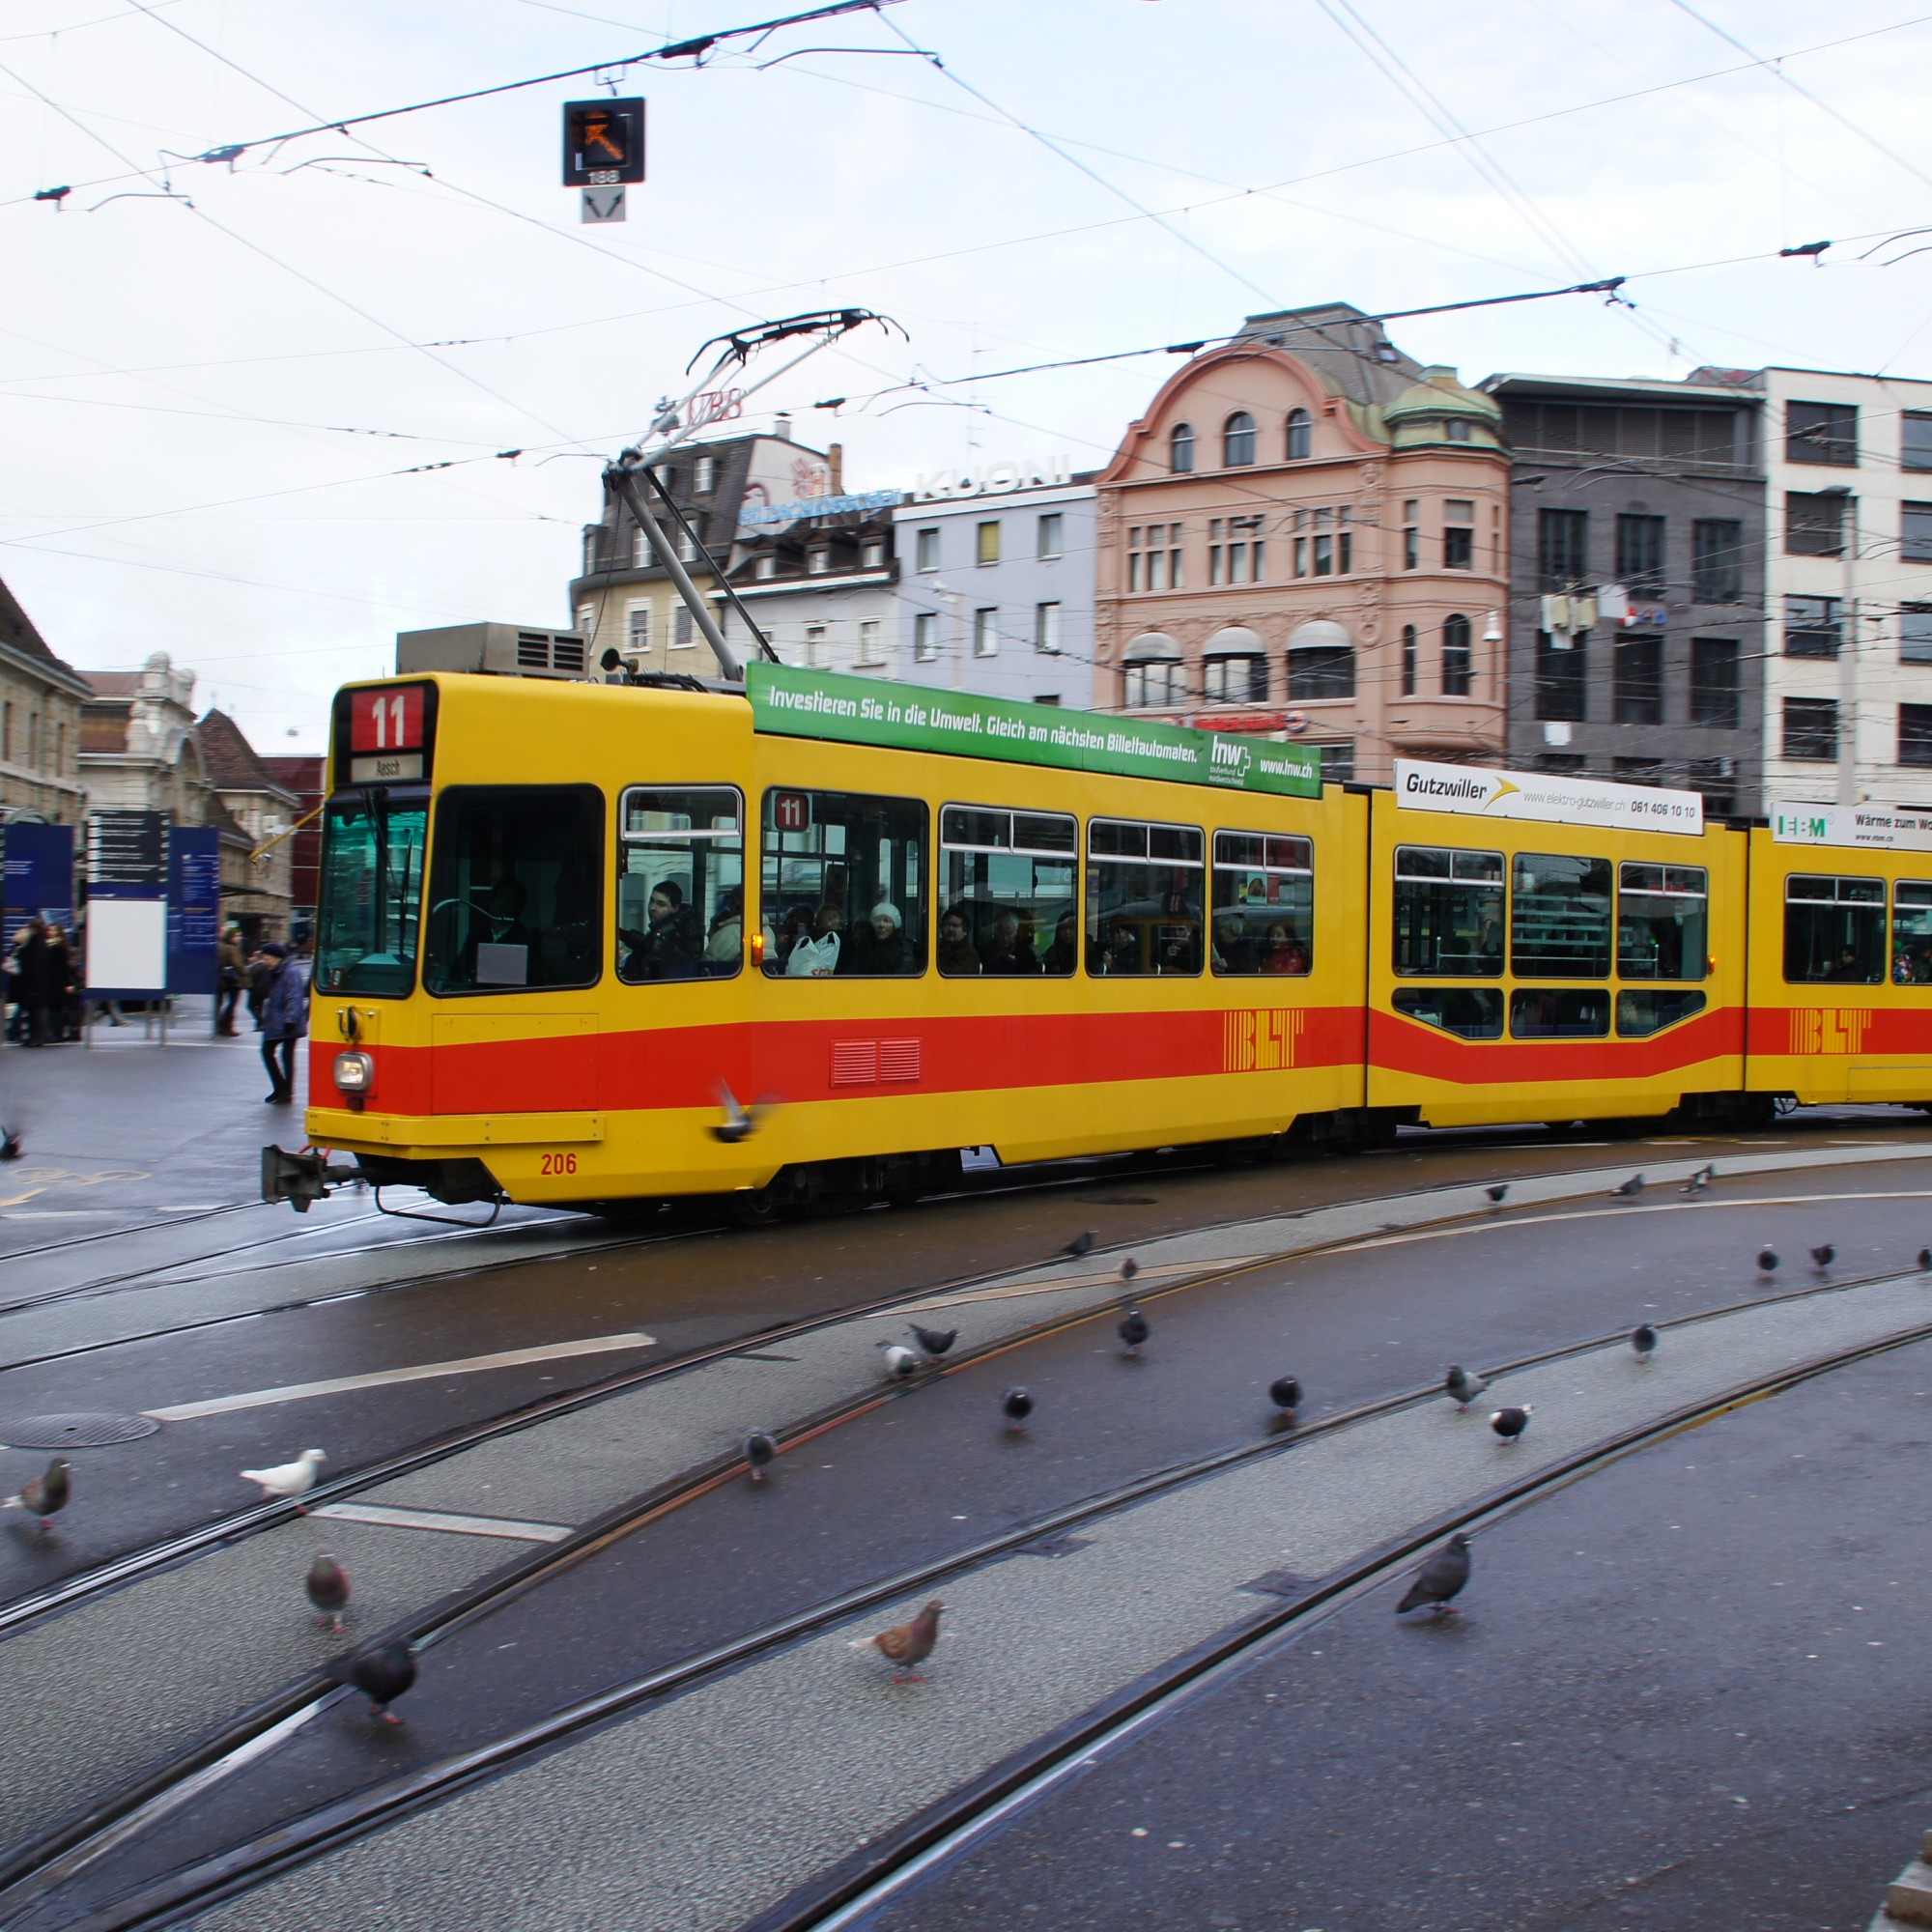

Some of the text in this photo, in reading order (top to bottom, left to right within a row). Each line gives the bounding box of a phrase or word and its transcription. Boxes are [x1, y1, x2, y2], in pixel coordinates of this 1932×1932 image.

[913, 454, 1072, 502] KUONI
[372, 695, 405, 749] 11
[769, 685, 1198, 763] Investieren Sie in die Umwelt. Gleich am nächsten Billettautomaten.
[1406, 773, 1488, 800] Gutzwiller
[781, 799, 800, 826] 11
[1523, 792, 1626, 811] www.elektro-gutzwiller.ch
[1631, 801, 1695, 818] 061 406 10 10
[1855, 814, 1892, 828] Wärme
[1894, 818, 1916, 830] zum
[1223, 1009, 1304, 1071] BLT
[1789, 1009, 1872, 1054] BLT
[541, 1152, 577, 1176] 206
